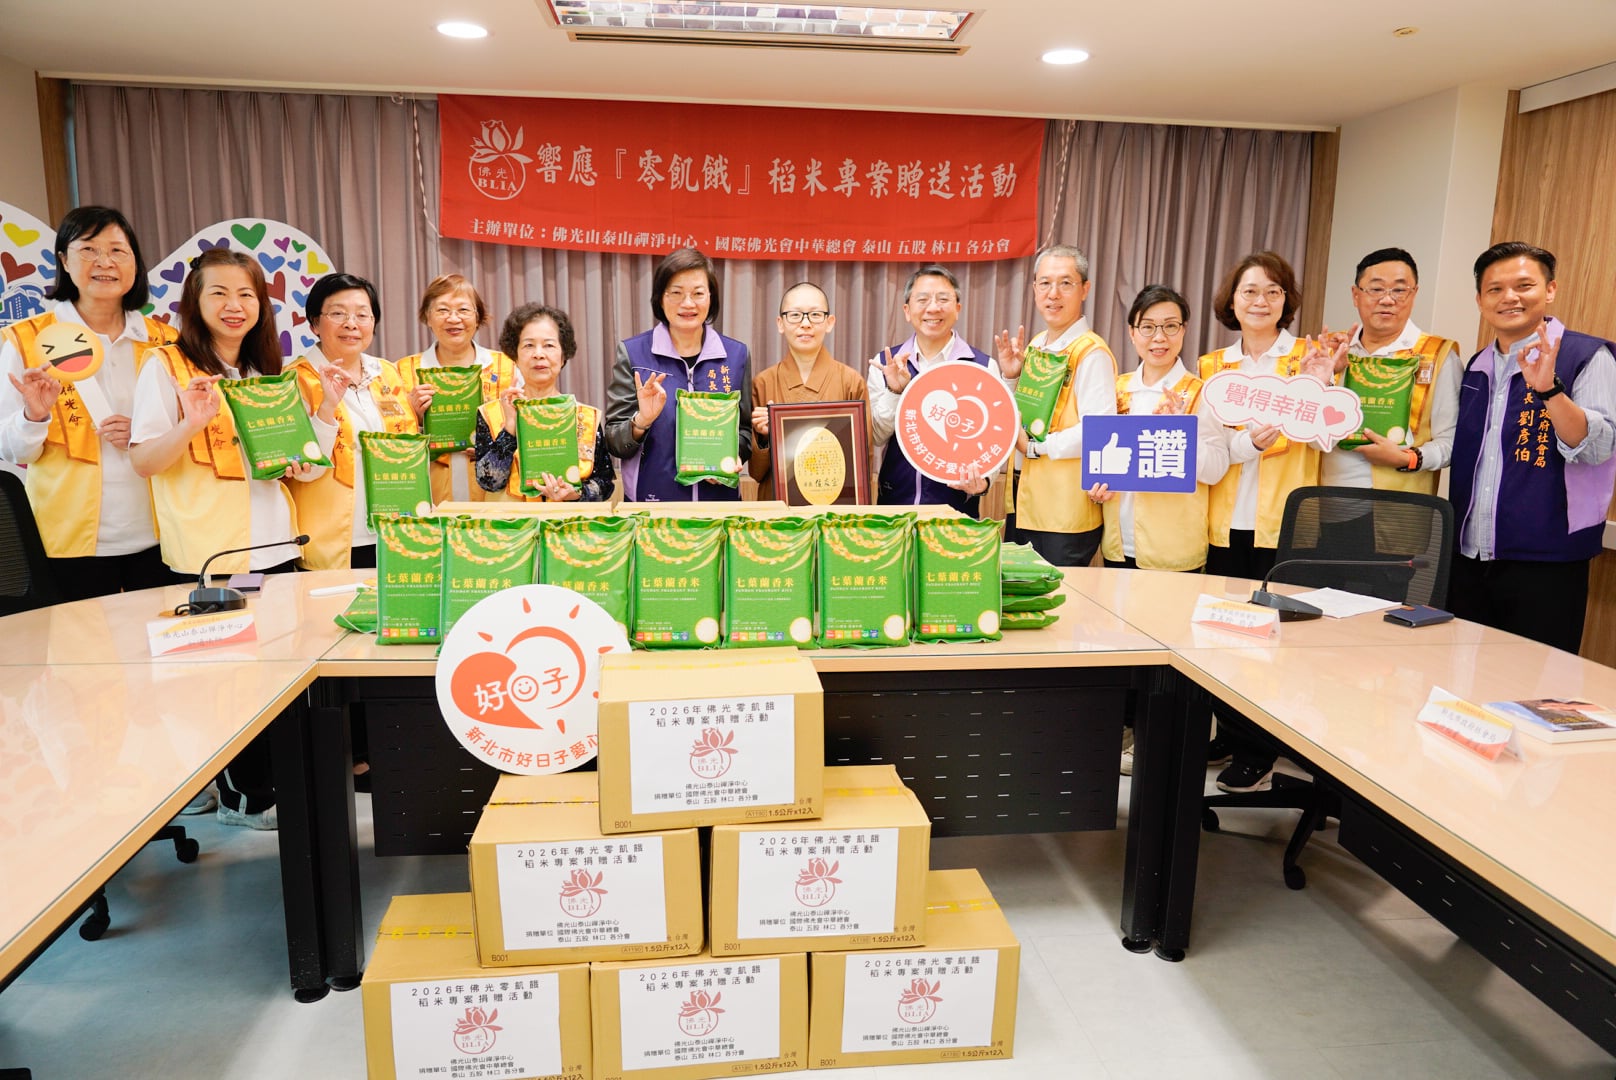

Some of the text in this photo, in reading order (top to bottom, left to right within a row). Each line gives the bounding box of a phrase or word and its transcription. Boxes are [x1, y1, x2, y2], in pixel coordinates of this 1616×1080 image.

[478, 166, 508, 180] 佛光
[478, 178, 517, 192] BLIA
[862, 239, 891, 254] 泰山
[897, 239, 926, 255] 五股
[931, 239, 960, 255] 林口
[967, 238, 1011, 255] 各分會
[707, 369, 718, 391] 局長
[720, 365, 731, 393] 新北市
[1223, 382, 1320, 424] 覺得幸福
[1515, 409, 1535, 463] 劉彥伯
[1138, 429, 1187, 479] 讚
[451, 577, 512, 588] 七葉蘭香米
[641, 577, 700, 588] 七葉蘭香米
[736, 577, 794, 588] 七葉蘭香米
[831, 575, 888, 586] 七葉蘭香米
[926, 571, 982, 582] 七葉蘭香米
[656, 713, 769, 727] 稻米專案捐贈活動
[765, 845, 873, 856] 稻米專案捐贈活動
[525, 855, 637, 869] 稻米專案捐贈活動
[870, 966, 973, 977] 稻米專案捐贈活動
[646, 976, 755, 991] 稻米專案捐贈活動
[419, 992, 533, 1007] 稻米專案捐贈活動
